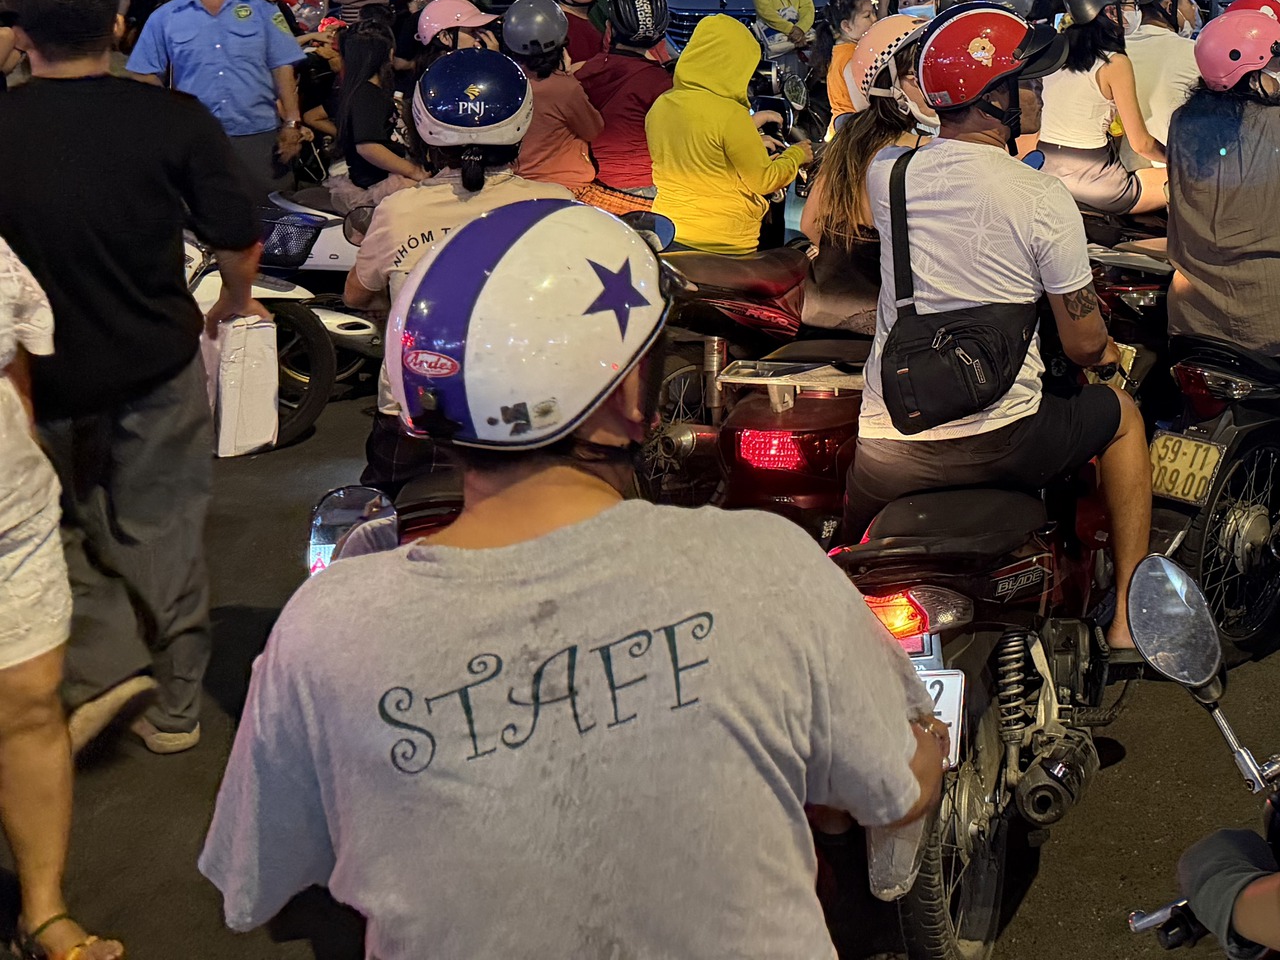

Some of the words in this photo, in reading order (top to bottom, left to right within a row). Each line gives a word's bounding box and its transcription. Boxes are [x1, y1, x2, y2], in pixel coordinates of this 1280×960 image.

[458, 101, 485, 117] PNJ
[393, 229, 434, 268] NHÓM
[1158, 436, 1212, 471] 59-T1
[996, 568, 1043, 602] BLADE
[378, 611, 714, 774] STAFF
